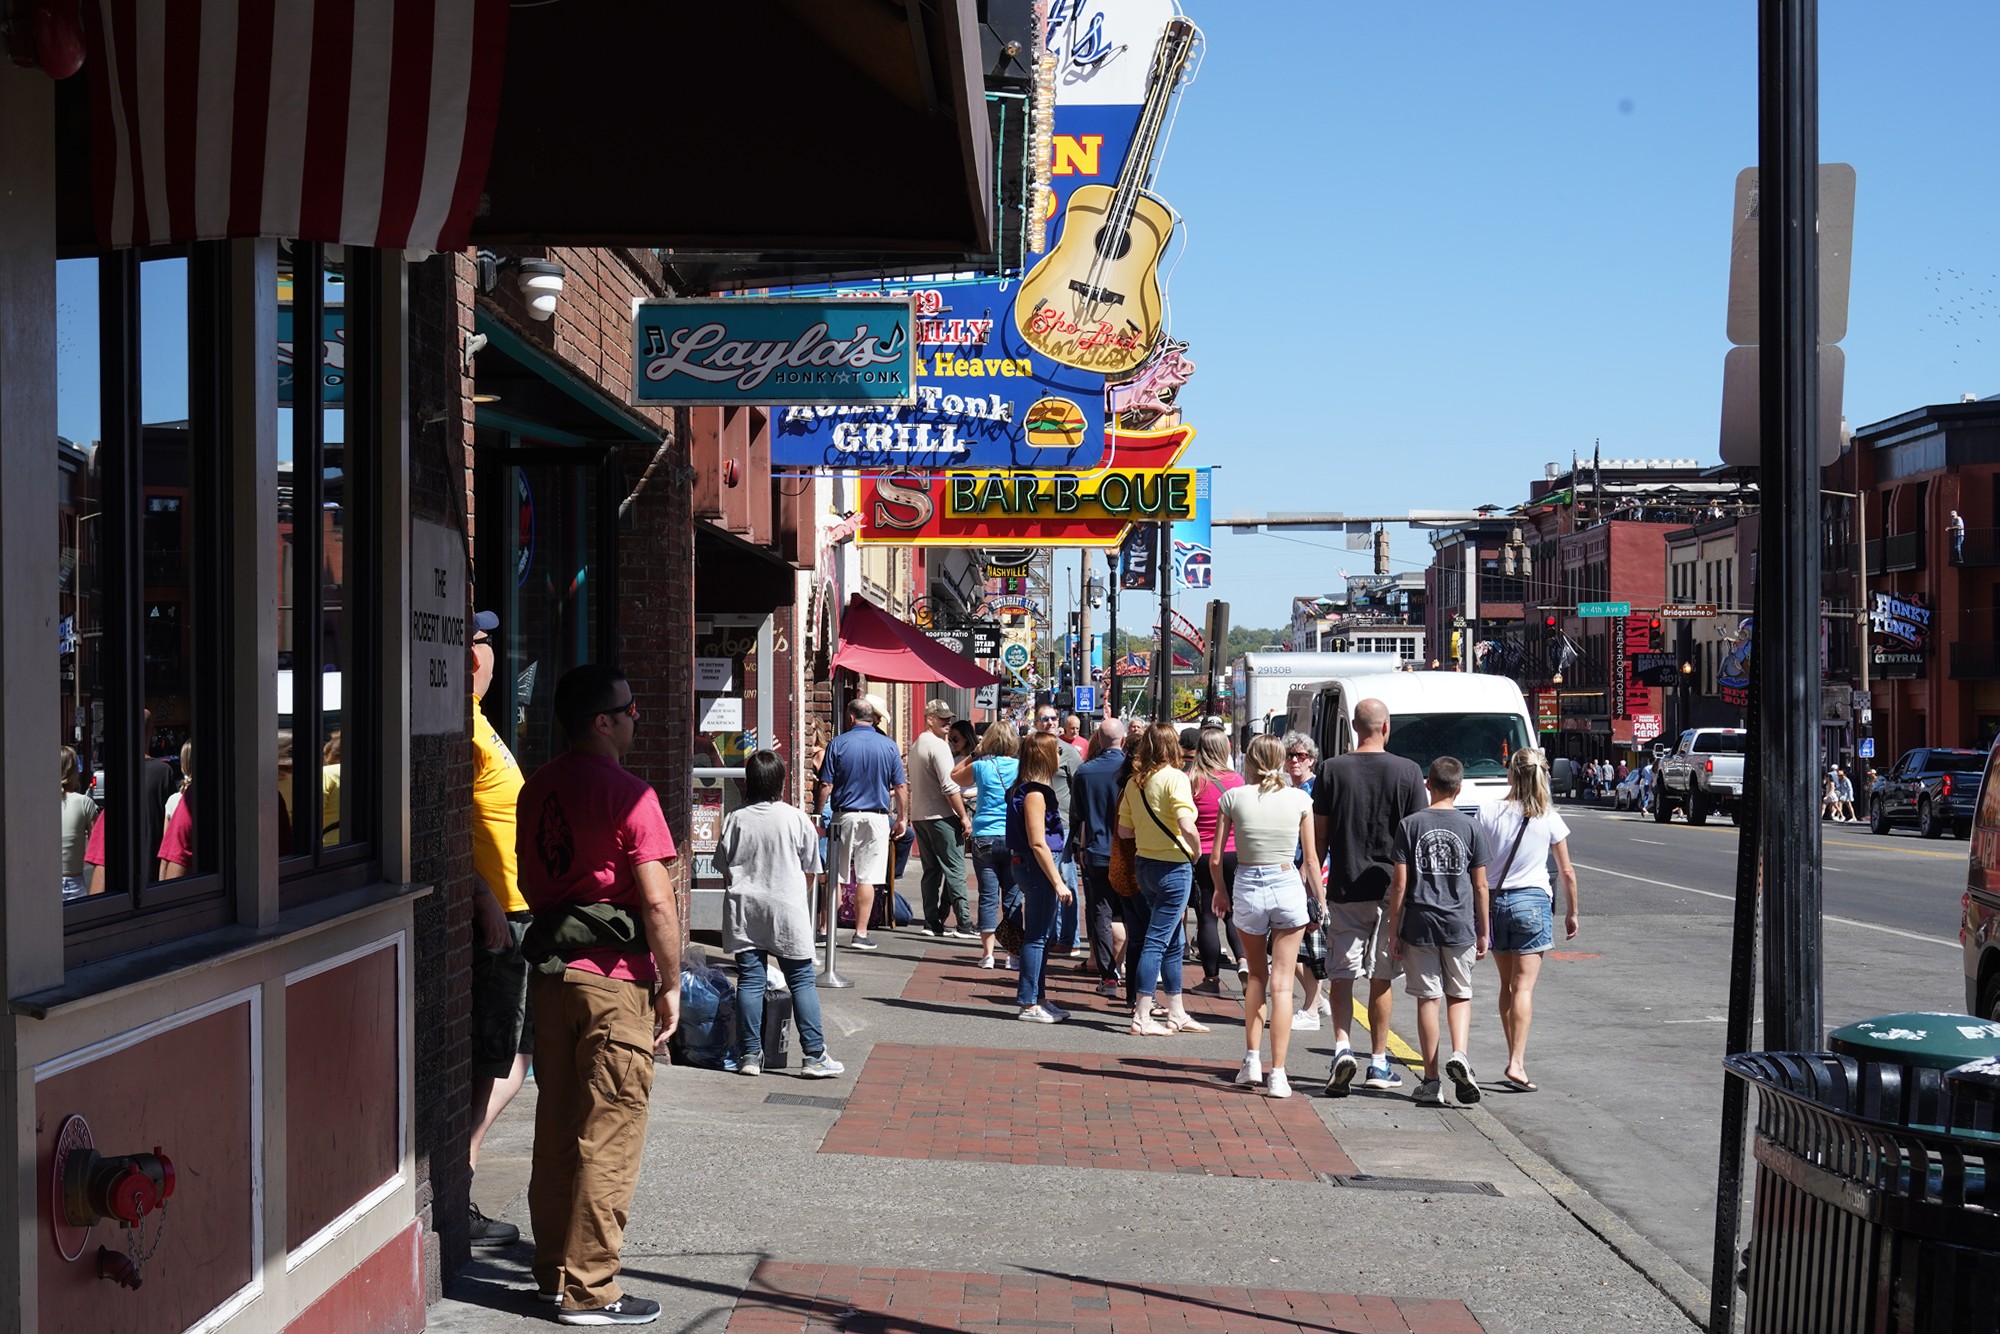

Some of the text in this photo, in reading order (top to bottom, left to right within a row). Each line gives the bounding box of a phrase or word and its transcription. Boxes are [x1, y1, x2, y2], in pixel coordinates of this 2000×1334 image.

[645, 322, 903, 391] Layla's
[934, 352, 1033, 377] Heaven
[775, 371, 903, 385] HONKY TONK
[917, 386, 1012, 423] Tonk
[832, 422, 966, 453] GRILL
[950, 472, 1191, 516] BAR-B-QUE
[434, 568, 447, 598] THE
[987, 563, 1028, 577] NASHVILLE
[1663, 608, 1706, 617] Bridgestone
[1876, 592, 1931, 626] HONKY
[413, 611, 464, 647] ROBERT MOORE
[1616, 616, 1624, 649] ITCHEN
[1869, 611, 1917, 642] TONK
[1257, 666, 1292, 675] 29130B
[1875, 653, 1923, 664] CENTRAL
[1634, 722, 1660, 730] PARK
[1634, 730, 1660, 738] HERE
[693, 822, 713, 839] $6
